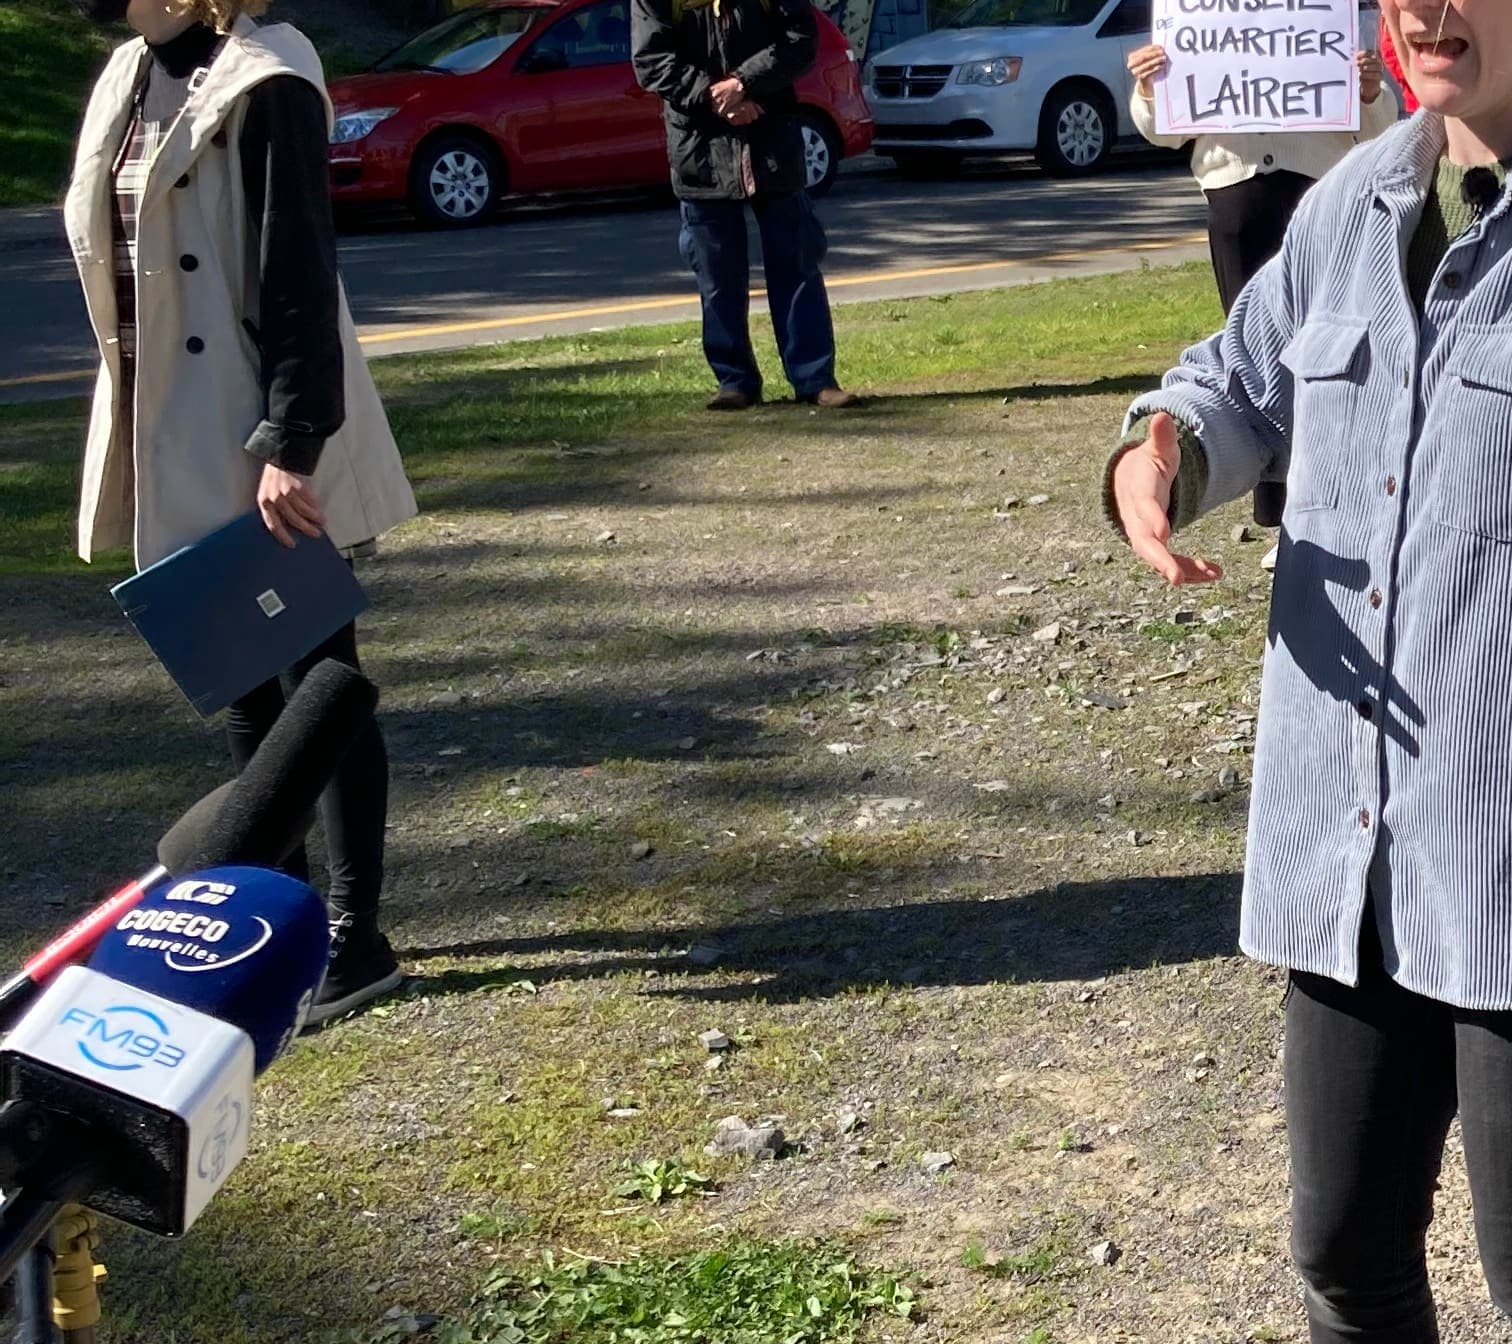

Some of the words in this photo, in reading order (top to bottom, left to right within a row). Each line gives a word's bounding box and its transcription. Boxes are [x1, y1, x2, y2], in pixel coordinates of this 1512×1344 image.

[1156, 16, 1174, 31] DE
[116, 909, 231, 943] COGECO
[126, 934, 221, 963] Nouvelles
[59, 1006, 186, 1068] FM93
